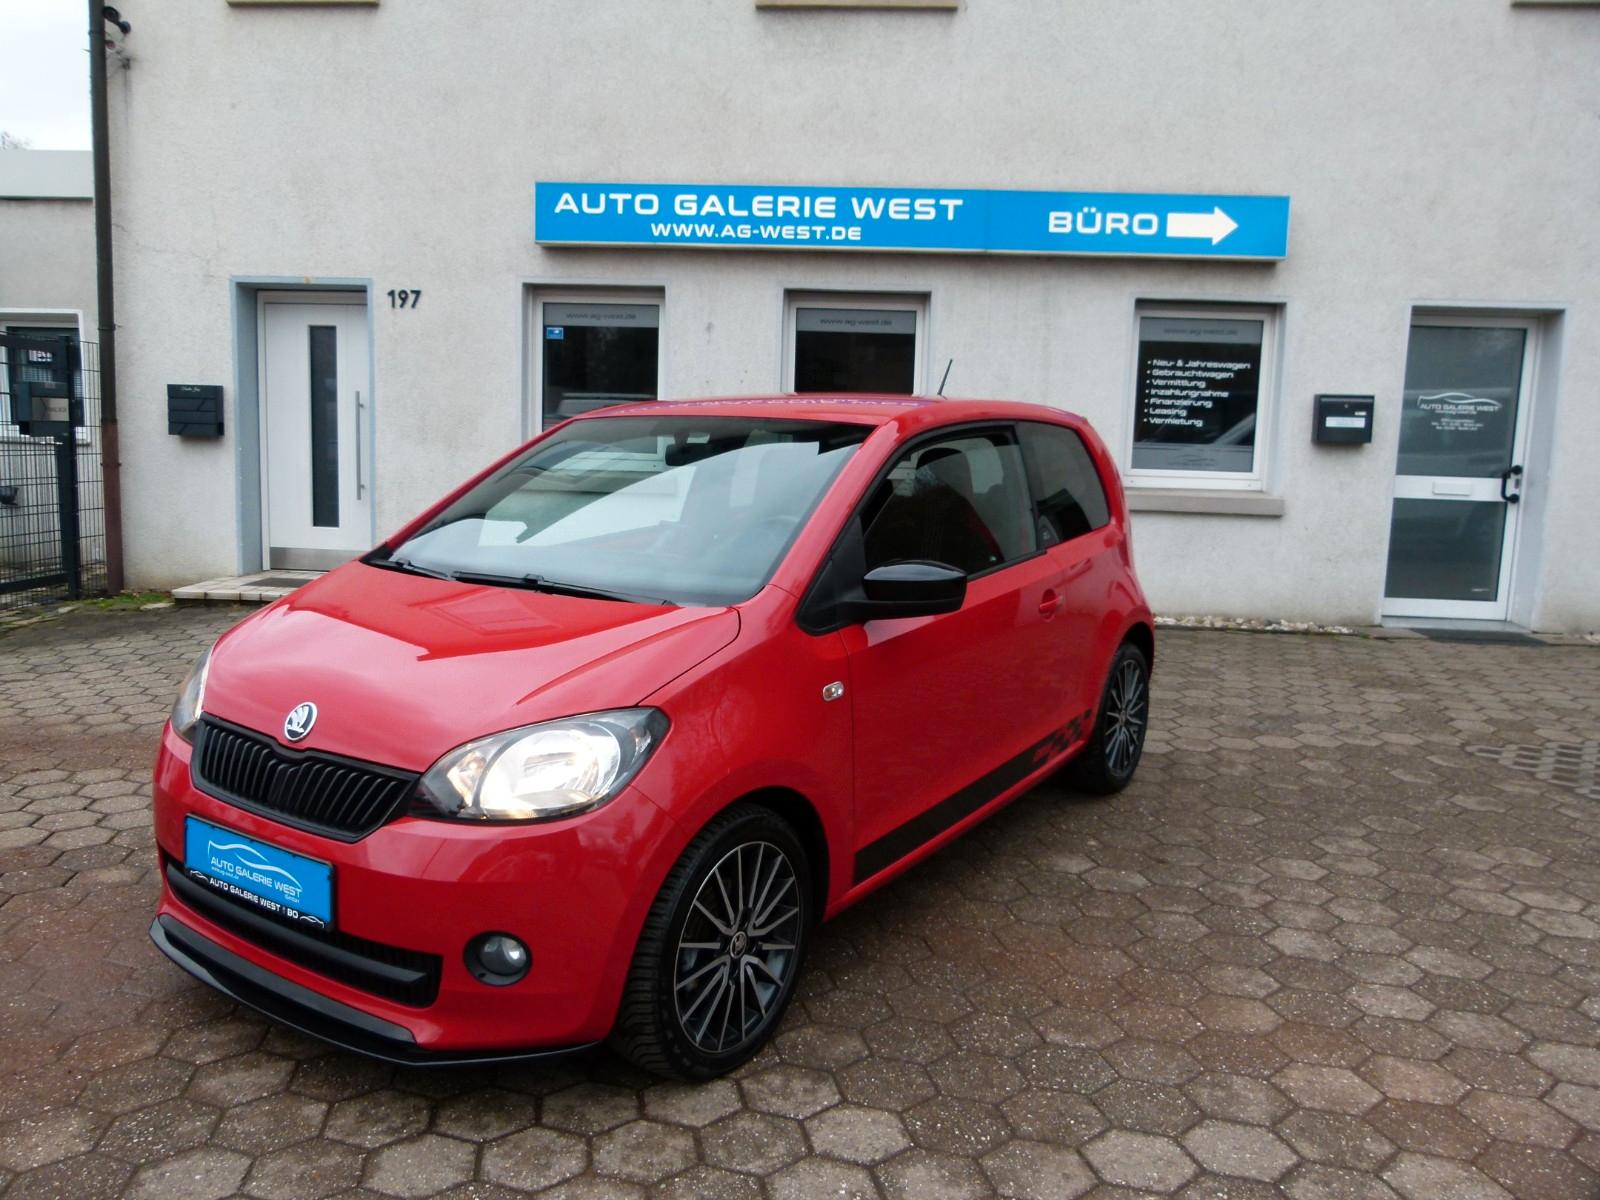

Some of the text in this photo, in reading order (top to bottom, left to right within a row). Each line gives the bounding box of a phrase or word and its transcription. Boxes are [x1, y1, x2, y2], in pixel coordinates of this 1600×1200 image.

[554, 193, 963, 221] AUTO GALERIE WEST
[1048, 206, 1159, 236] BÜRO
[651, 223, 862, 241] WWW.AG-WEST.DE
[387, 289, 422, 309] 197
[1185, 360, 1251, 371] Jahreswagen
[1152, 369, 1235, 379] Gebrauchtwagen
[1151, 378, 1207, 389] Vermittlung
[1150, 388, 1230, 398] Inzahlungnahme
[1149, 398, 1213, 409] Finanzierung
[1149, 407, 1188, 417] Leasing
[1149, 417, 1203, 428] Vermietung
[210, 856, 302, 898] AUTO GALERIE WEST
[209, 877, 229, 891] AUTO
[229, 885, 259, 903] GALERIE
[259, 896, 281, 912] WEST
